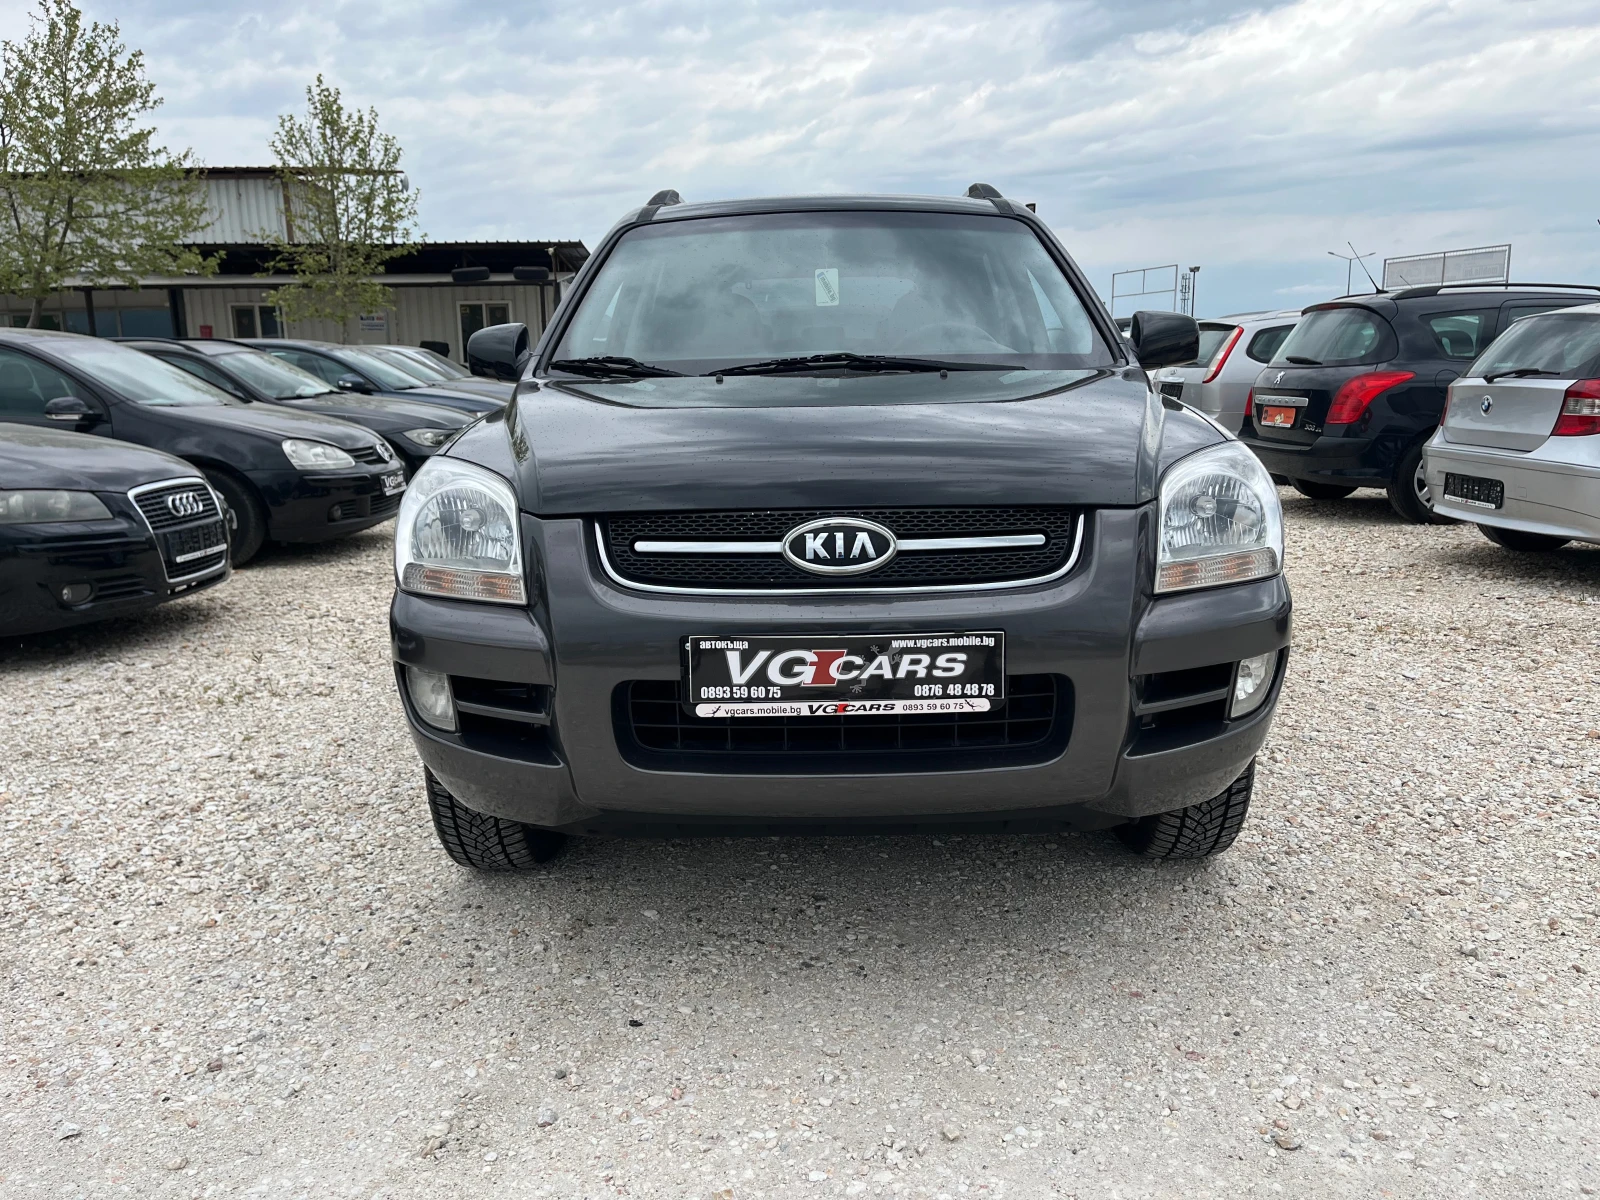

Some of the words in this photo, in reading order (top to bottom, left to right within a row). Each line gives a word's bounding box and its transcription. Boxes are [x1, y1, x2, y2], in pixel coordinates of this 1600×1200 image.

[804, 532, 877, 559] KIA
[699, 640, 749, 650] автокъща
[891, 636, 995, 649] www.vgcars.mobile.bg
[701, 686, 731, 698] 0893
[732, 686, 748, 698] 59
[750, 686, 766, 698] 60
[767, 686, 781, 698] 75
[914, 684, 943, 697] 0876
[947, 684, 962, 696] 48
[964, 684, 979, 696] 48
[981, 683, 995, 696] 78
[724, 705, 802, 716] vgcars.mobile.bg
[902, 703, 924, 711] 0893
[926, 703, 938, 711] 59
[953, 702, 964, 710] 75
